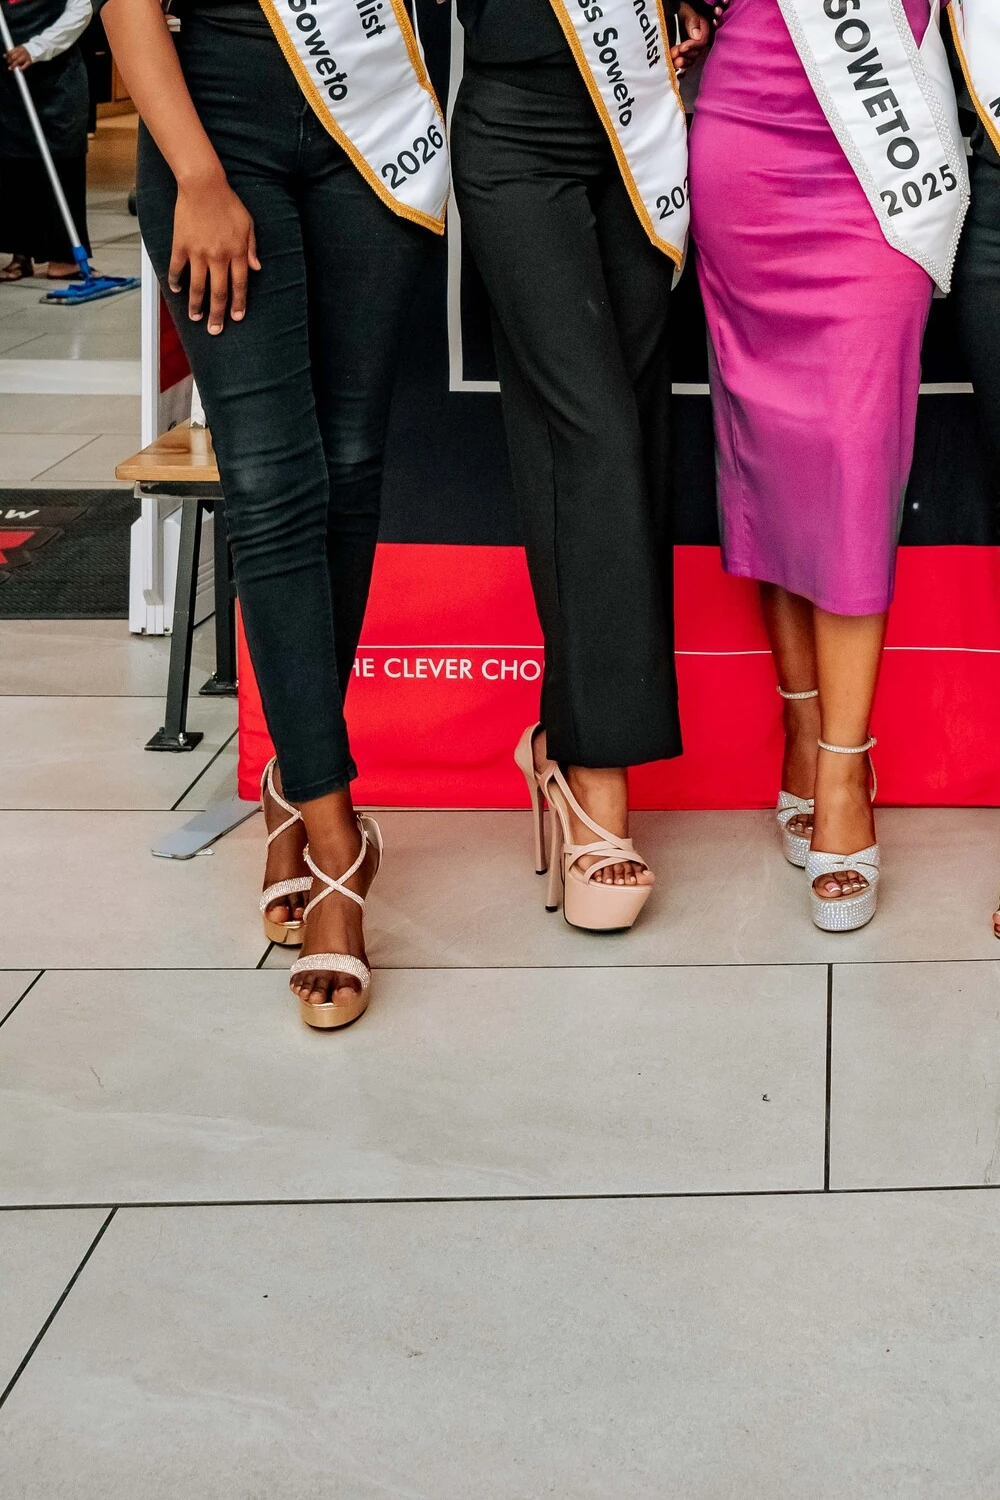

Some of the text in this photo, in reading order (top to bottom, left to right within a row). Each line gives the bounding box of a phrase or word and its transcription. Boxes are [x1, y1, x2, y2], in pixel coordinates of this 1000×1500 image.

[593, 27, 636, 127] Soweto
[381, 124, 444, 190] 2026
[879, 163, 958, 217] 2025
[383, 657, 473, 680] CLEVER
[481, 658, 545, 681] CHO
